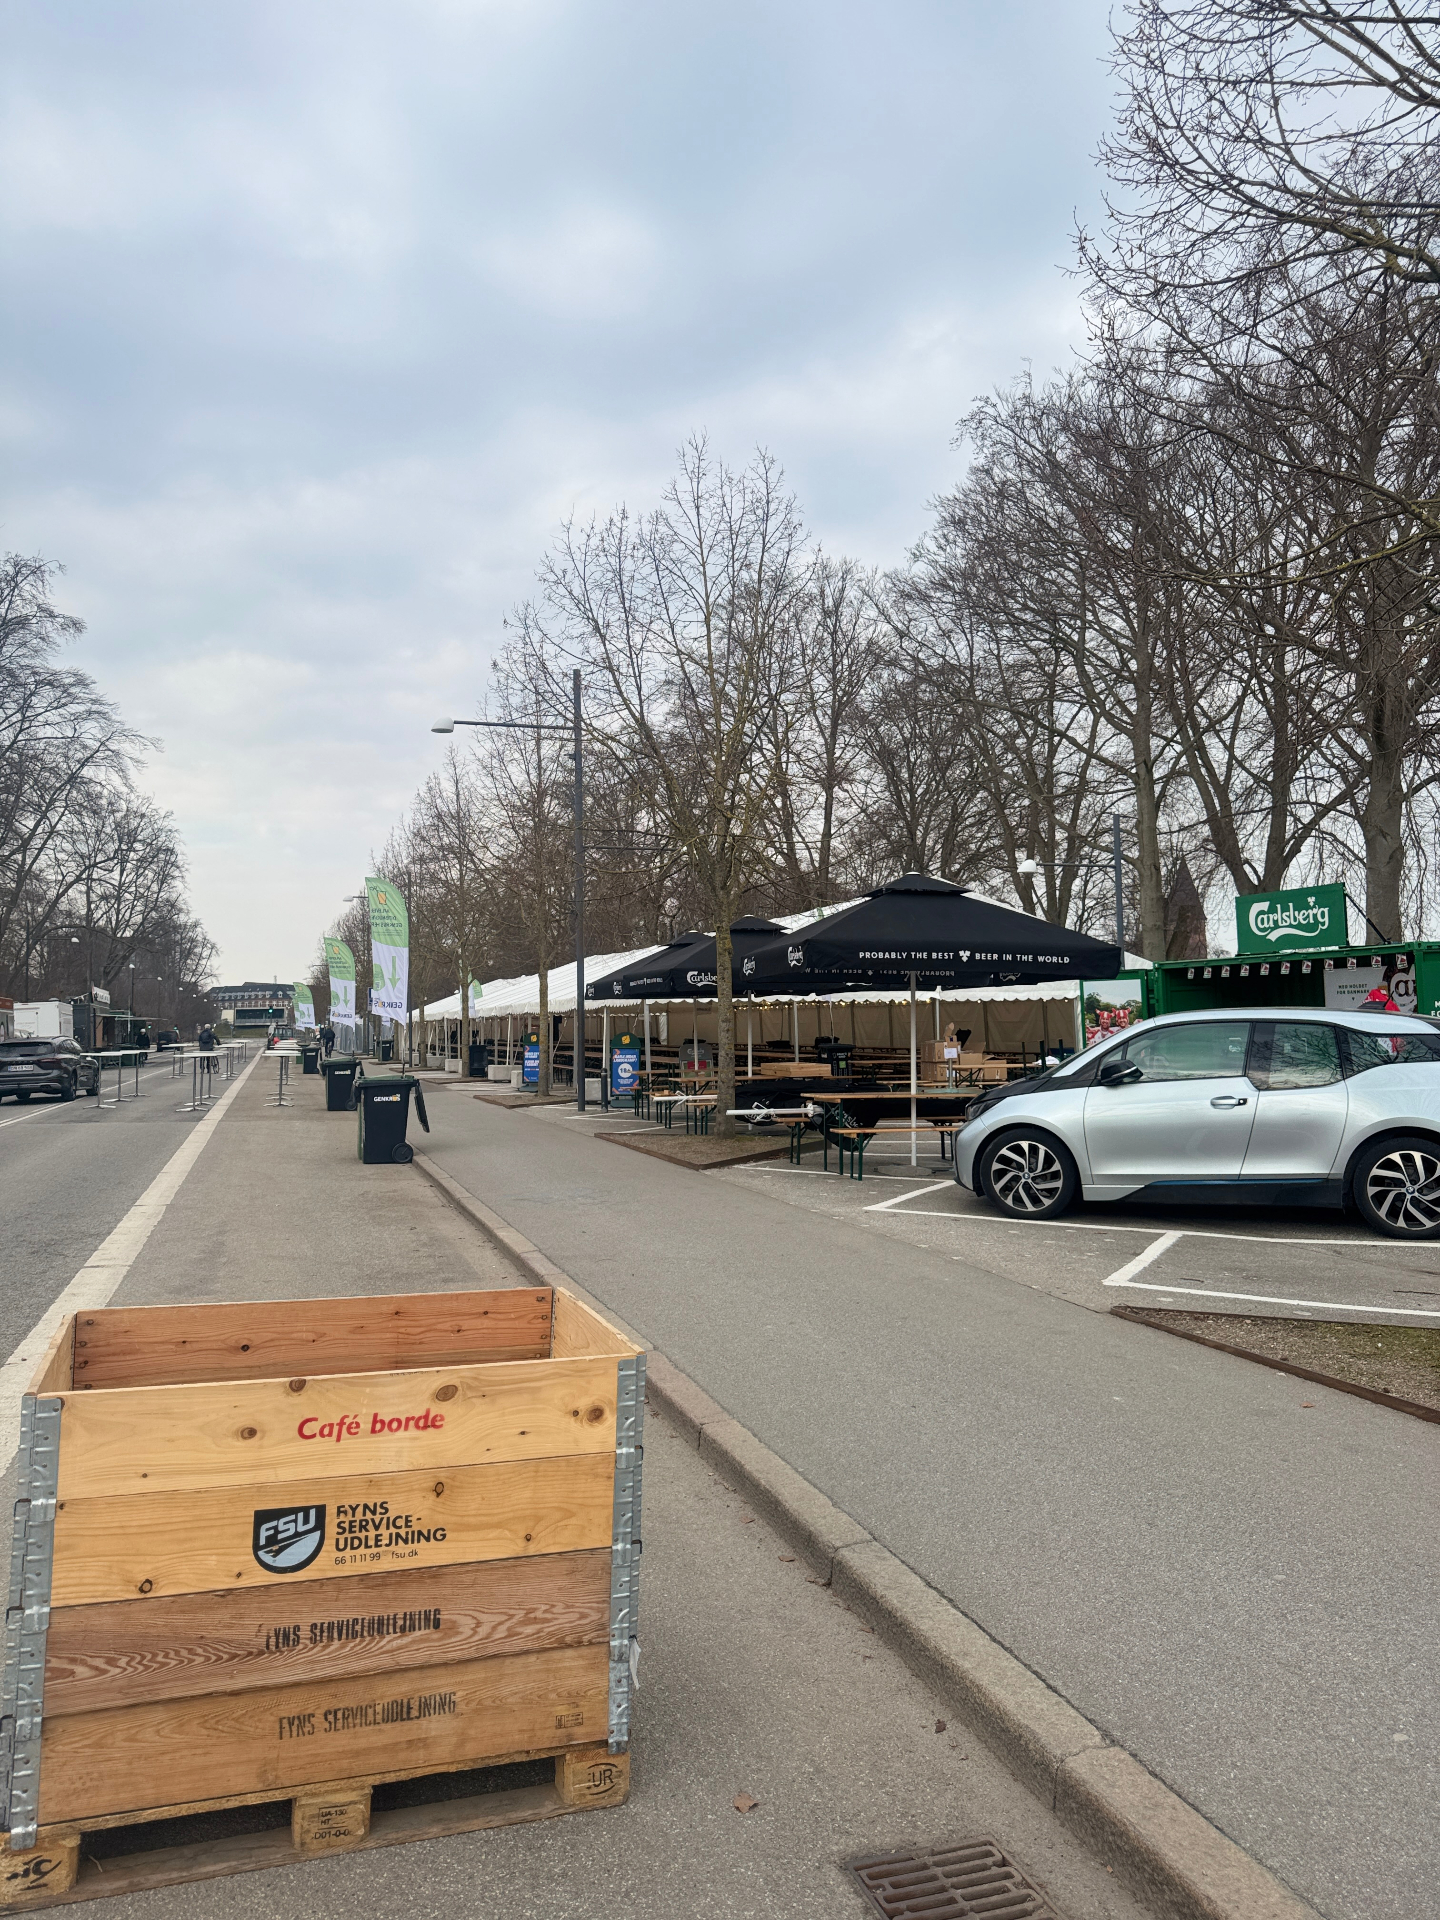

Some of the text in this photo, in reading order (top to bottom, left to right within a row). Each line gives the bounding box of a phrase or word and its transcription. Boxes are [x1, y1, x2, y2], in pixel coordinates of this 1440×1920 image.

[1248, 901, 1329, 938] Carlsberg
[859, 951, 908, 959] PROBABLY
[931, 952, 955, 960] BEST
[975, 953, 999, 961] BEER
[1017, 954, 1034, 962] THE
[1037, 955, 1070, 964] WORLD
[686, 971, 718, 986] Carlsbe
[297, 1407, 446, 1443] Café borde
[336, 1501, 389, 1519] FYNS
[260, 1508, 316, 1546] FSU
[336, 1514, 422, 1536] SERVICE-
[335, 1527, 447, 1552] UDLEJNING
[334, 1555, 347, 1565] 66
[350, 1554, 357, 1563] 11
[360, 1553, 367, 1562] 11
[369, 1552, 381, 1561] 99
[278, 1691, 457, 1740] FYNS SERVICEUDLEJNING
